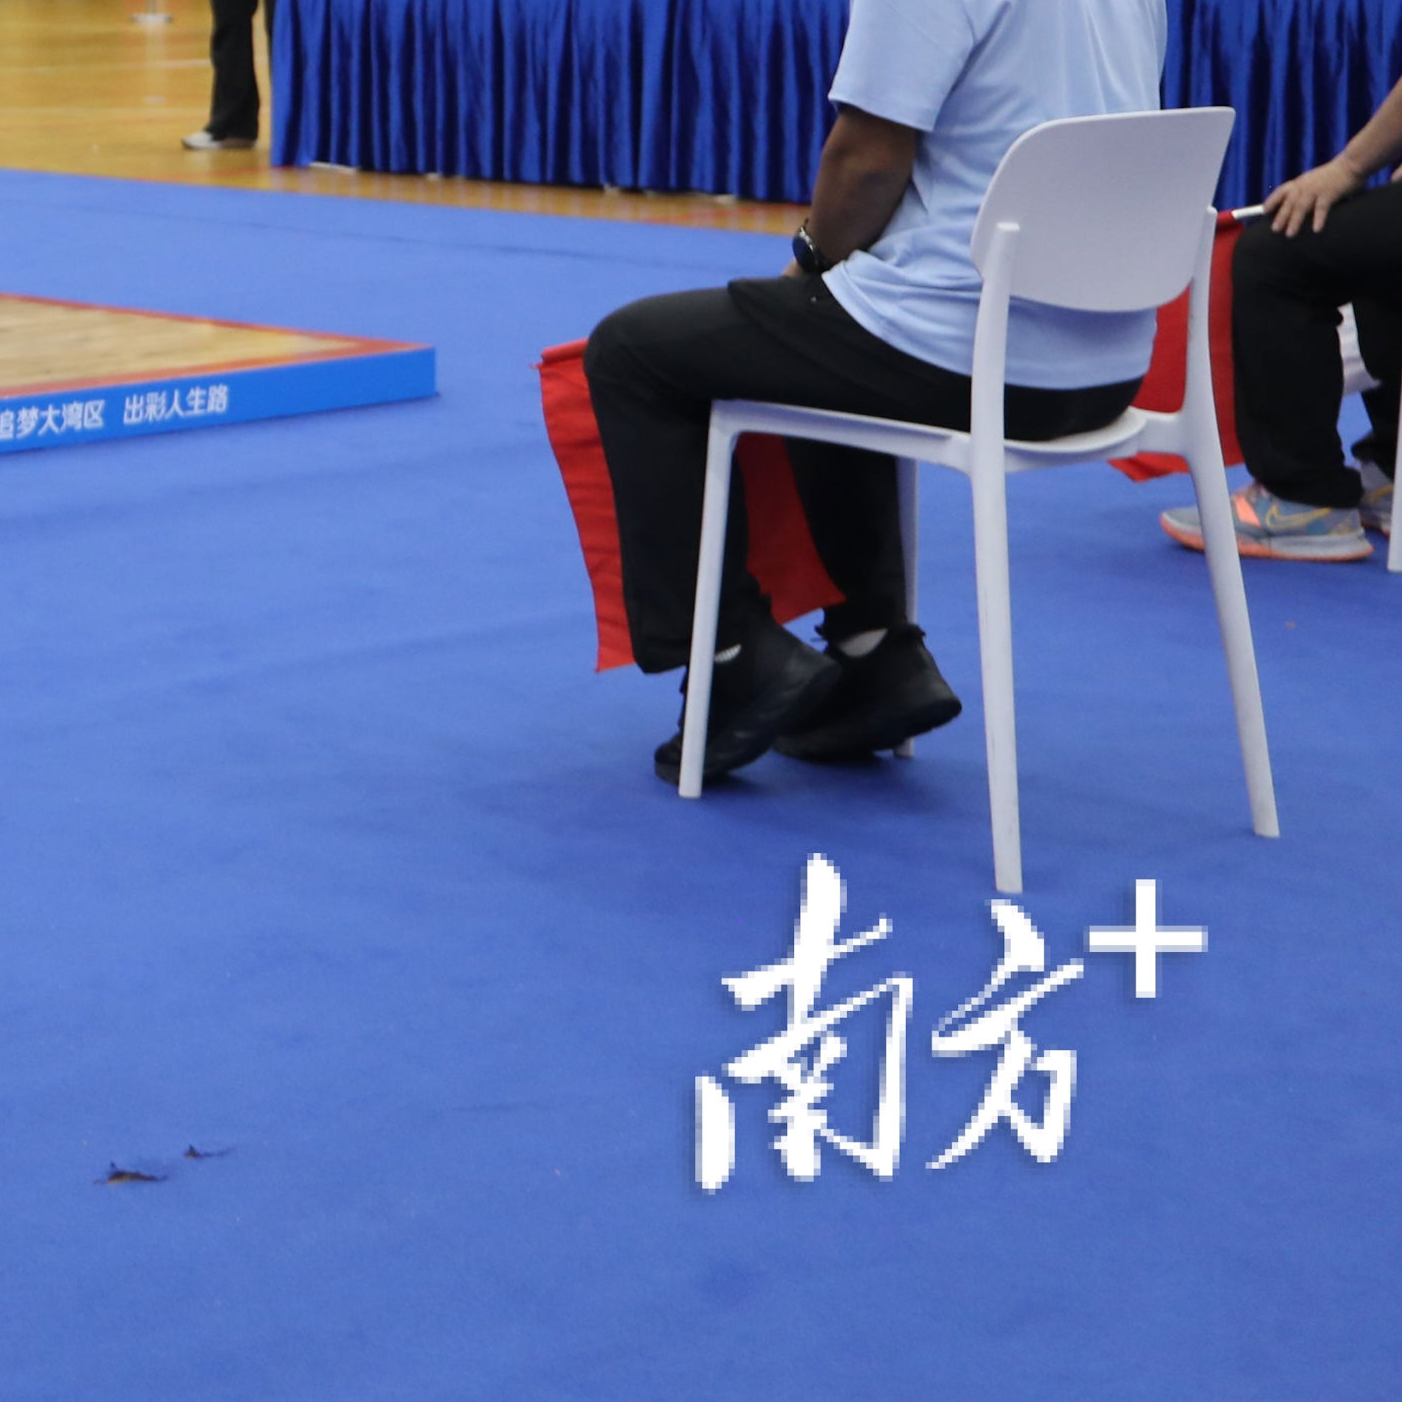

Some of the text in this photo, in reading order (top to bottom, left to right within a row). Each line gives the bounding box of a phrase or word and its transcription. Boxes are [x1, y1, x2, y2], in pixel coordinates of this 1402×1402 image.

[122, 384, 230, 426] 出彩人生路
